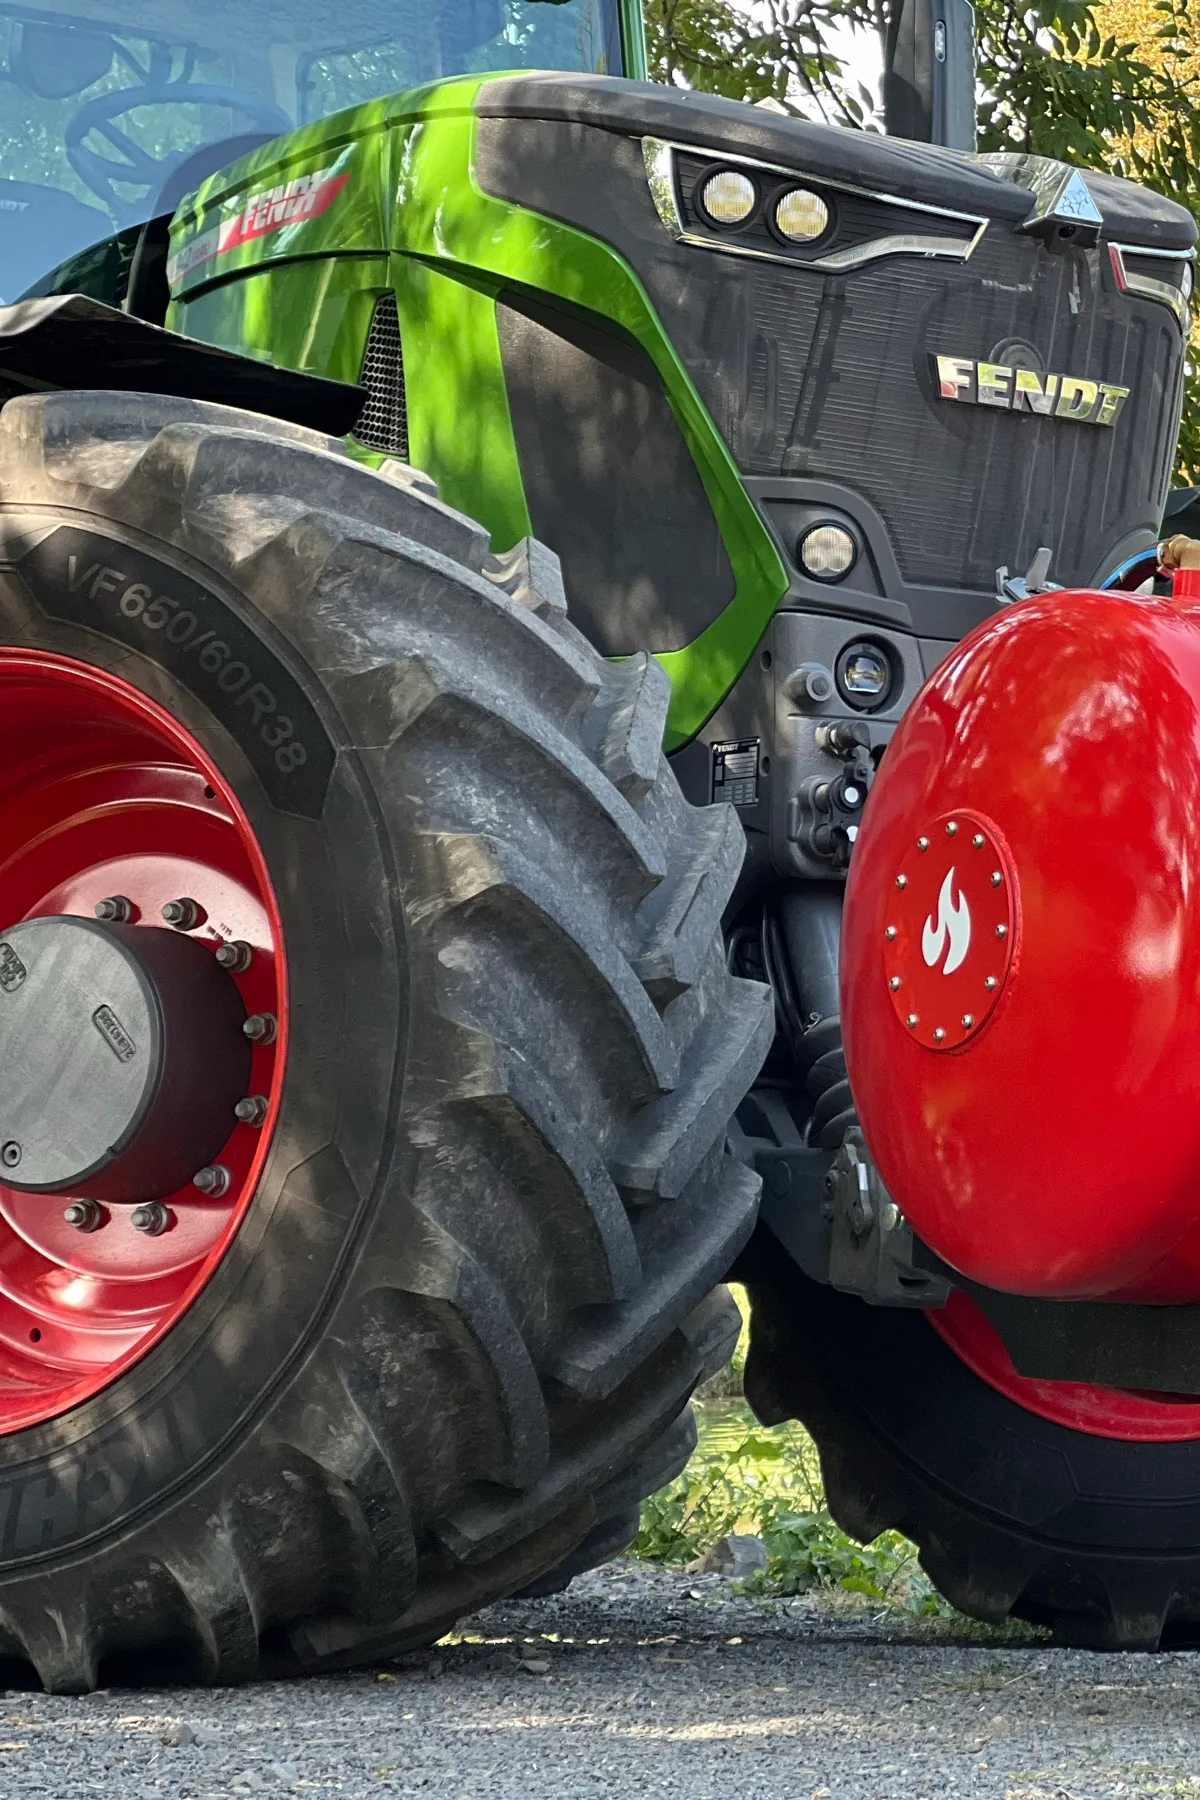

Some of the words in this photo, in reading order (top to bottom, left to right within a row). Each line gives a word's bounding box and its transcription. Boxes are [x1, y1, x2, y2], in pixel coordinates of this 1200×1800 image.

[240, 168, 329, 235] FENDT
[936, 355, 1130, 424] FENDT
[67, 556, 307, 774] VF650/60R38
